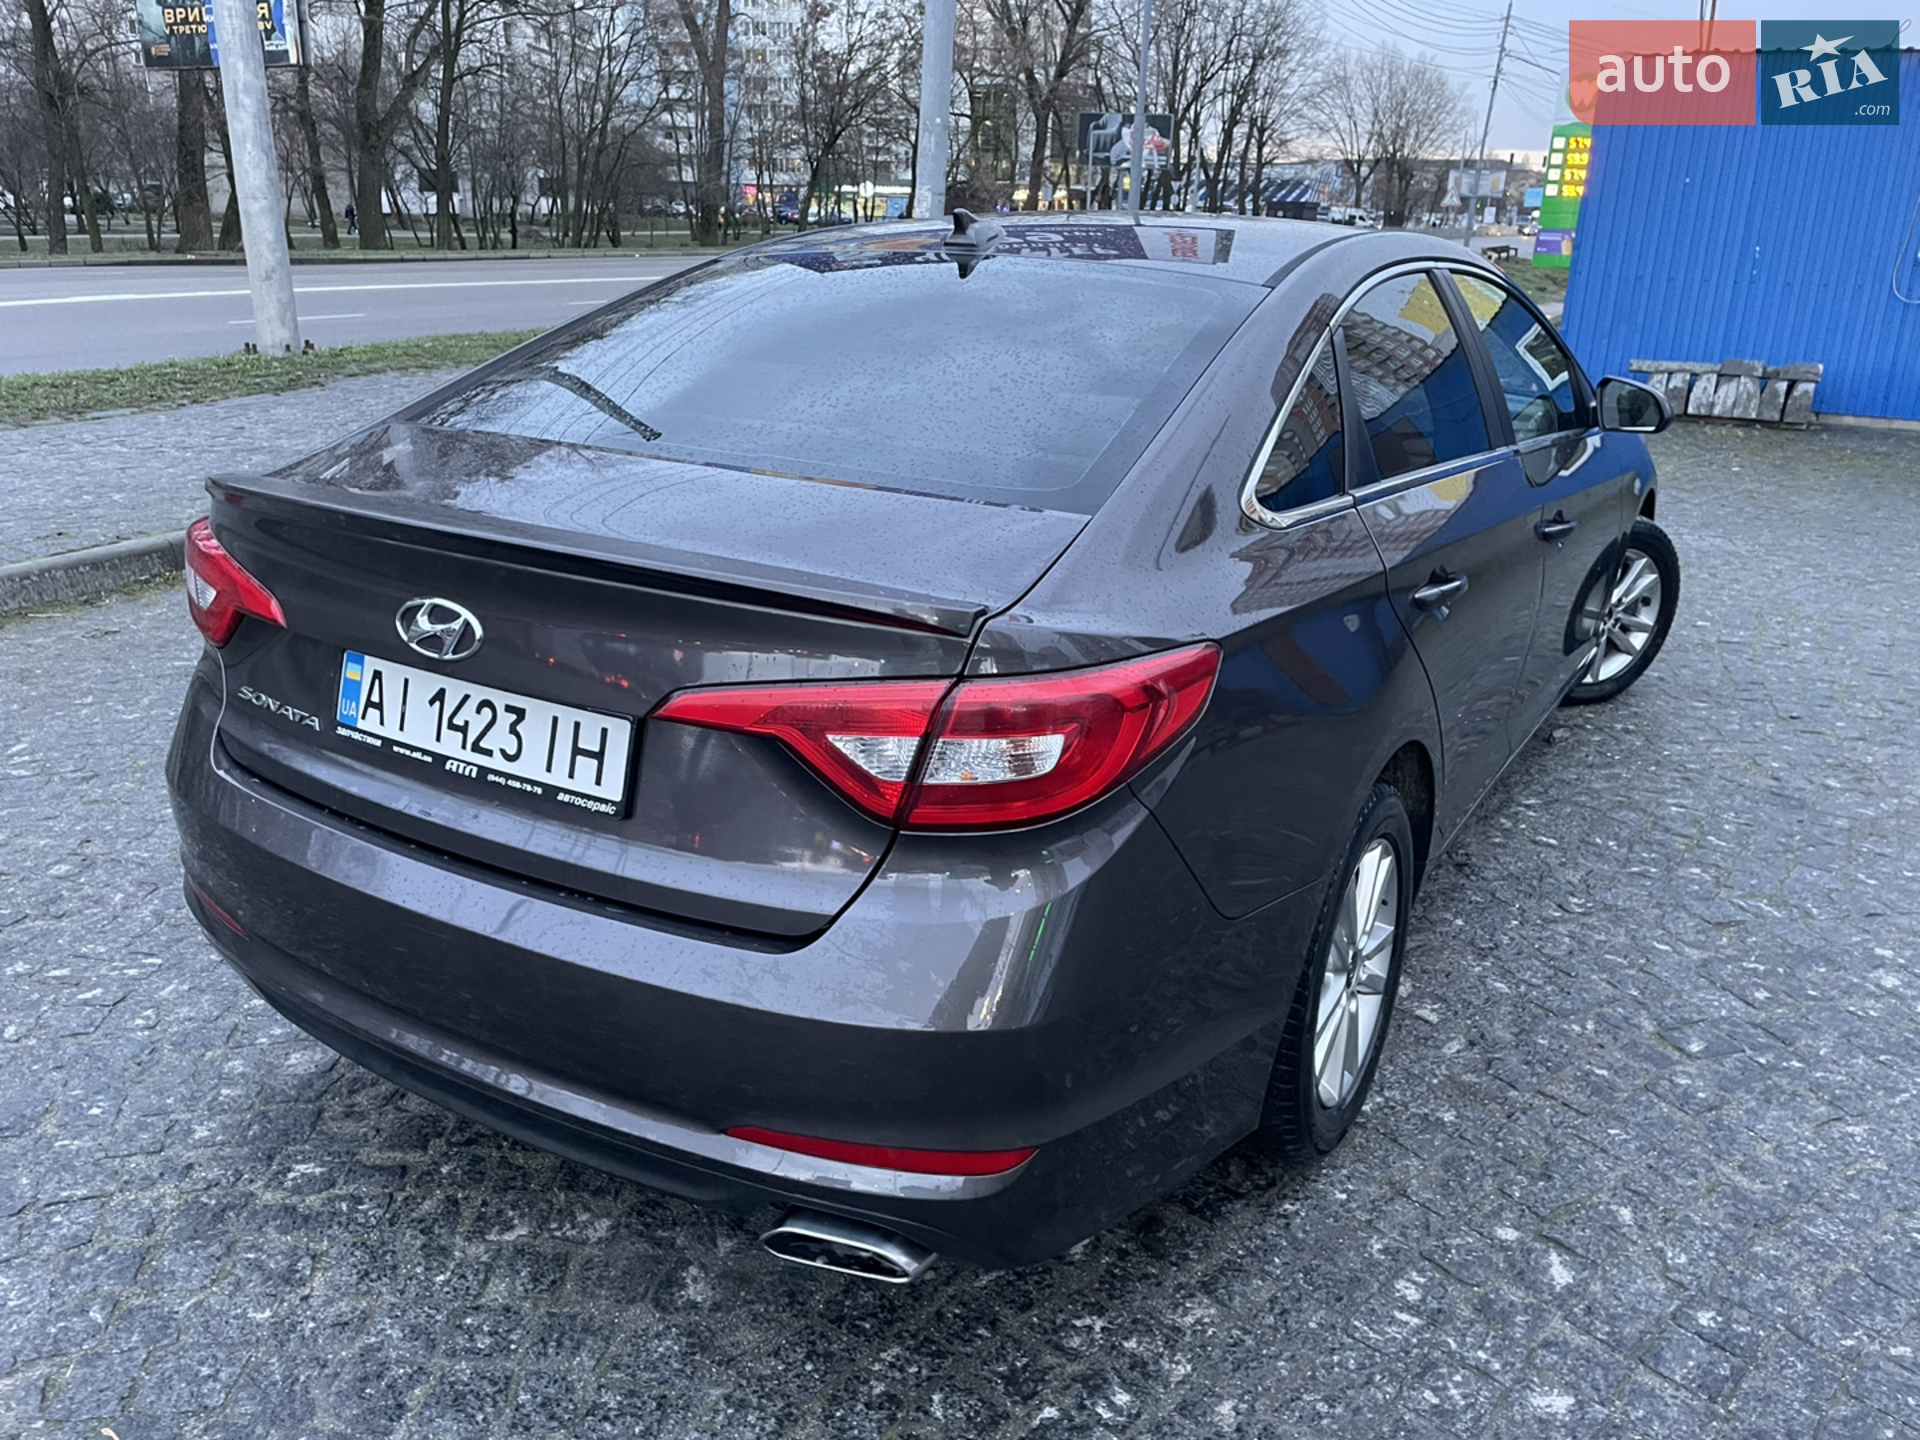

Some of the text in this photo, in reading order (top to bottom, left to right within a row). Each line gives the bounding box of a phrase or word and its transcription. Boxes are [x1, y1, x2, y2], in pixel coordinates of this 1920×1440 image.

[172, 24, 208, 35] ТРЕТЮ
[237, 684, 320, 732] SONATA
[341, 698, 357, 718] UA
[361, 668, 609, 787] AI 1423 IH
[557, 791, 617, 815] автосервіс
